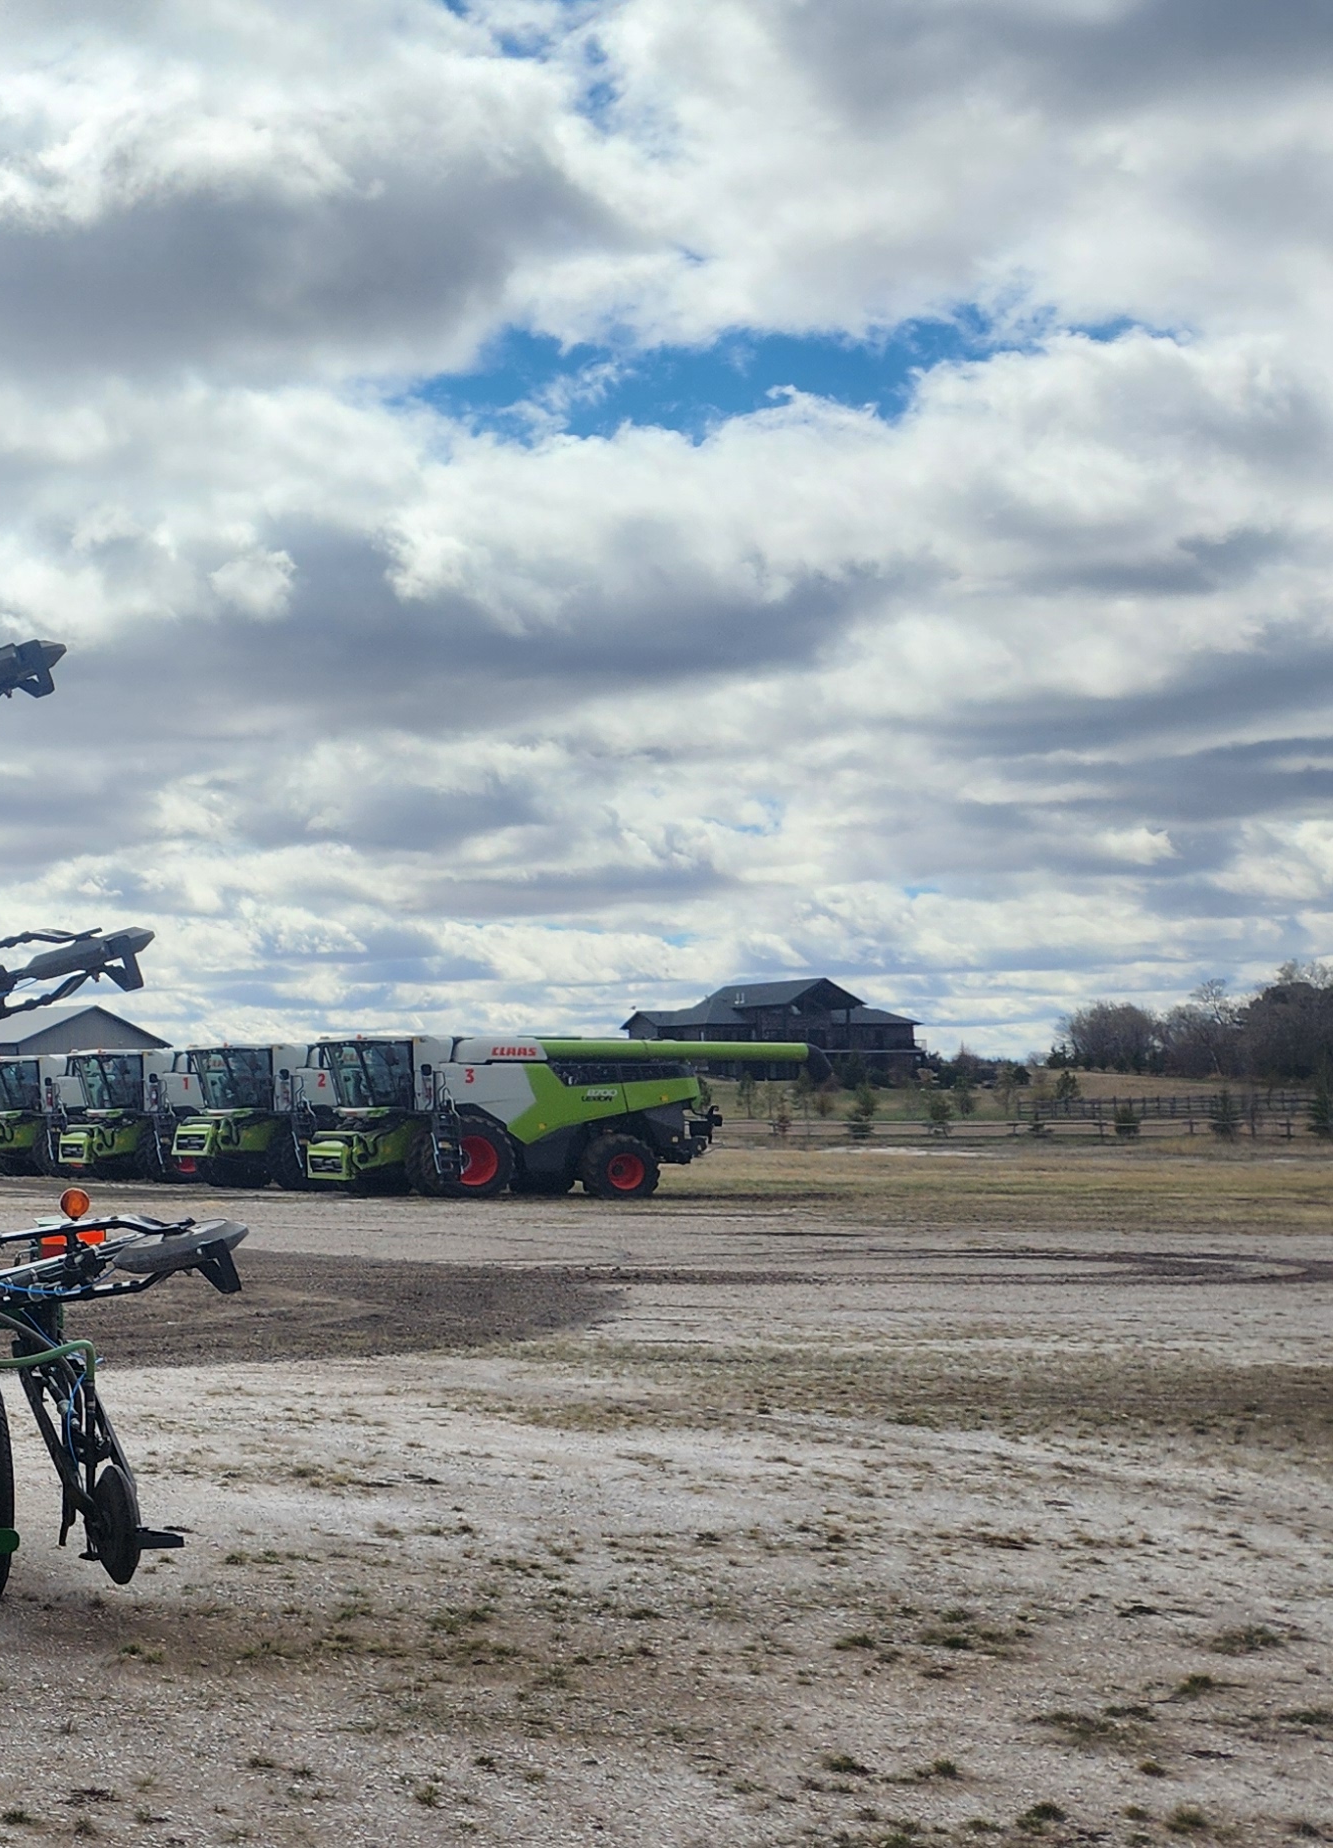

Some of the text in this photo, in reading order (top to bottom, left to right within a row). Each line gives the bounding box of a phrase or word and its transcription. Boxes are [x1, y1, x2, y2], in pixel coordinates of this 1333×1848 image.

[491, 1046, 537, 1057] CLAAS
[317, 1073, 326, 1088] 2
[465, 1068, 475, 1084] 3
[182, 1077, 189, 1090] 1
